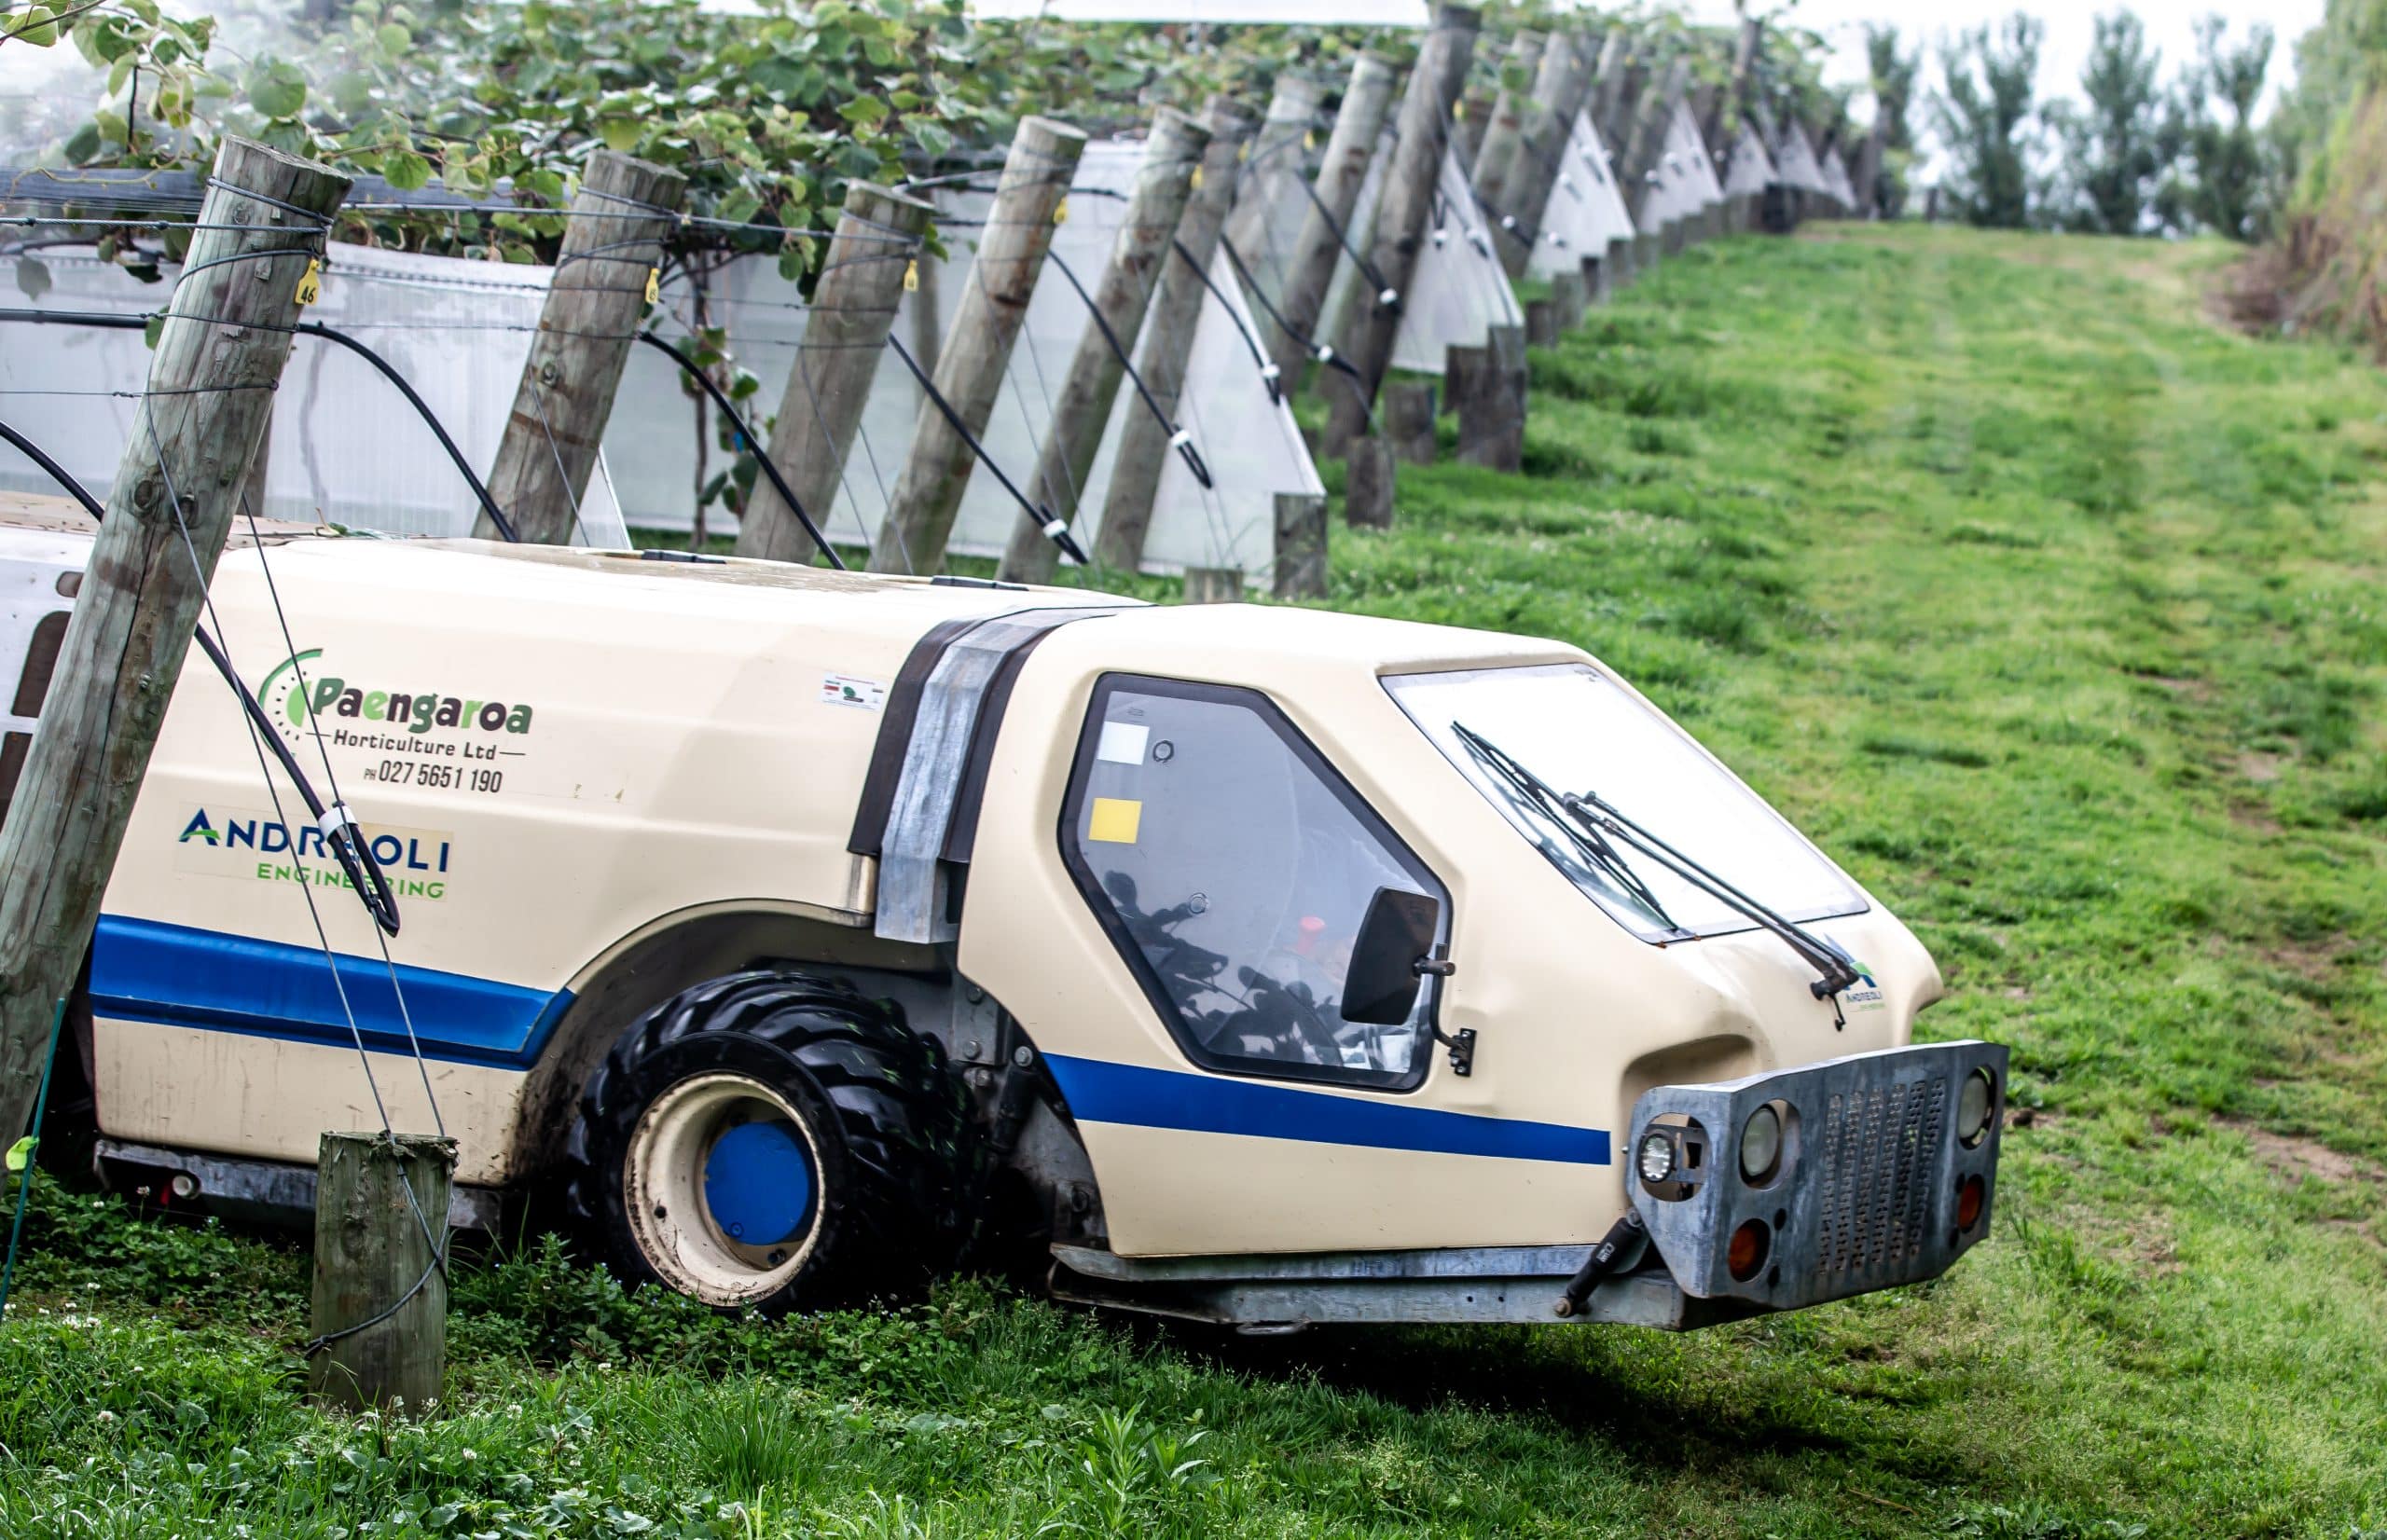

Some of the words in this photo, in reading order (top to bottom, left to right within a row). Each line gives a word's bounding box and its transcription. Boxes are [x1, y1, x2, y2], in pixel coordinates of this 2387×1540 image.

[300, 285, 316, 303] 46
[312, 678, 533, 735] Paengaroa
[333, 729, 456, 756] Horticulture
[463, 742, 496, 761] Ltd
[364, 768, 377, 781] PH
[379, 760, 415, 784] 027
[417, 763, 462, 790] 5651
[470, 768, 503, 793] 190
[178, 807, 450, 873] ANDROLI
